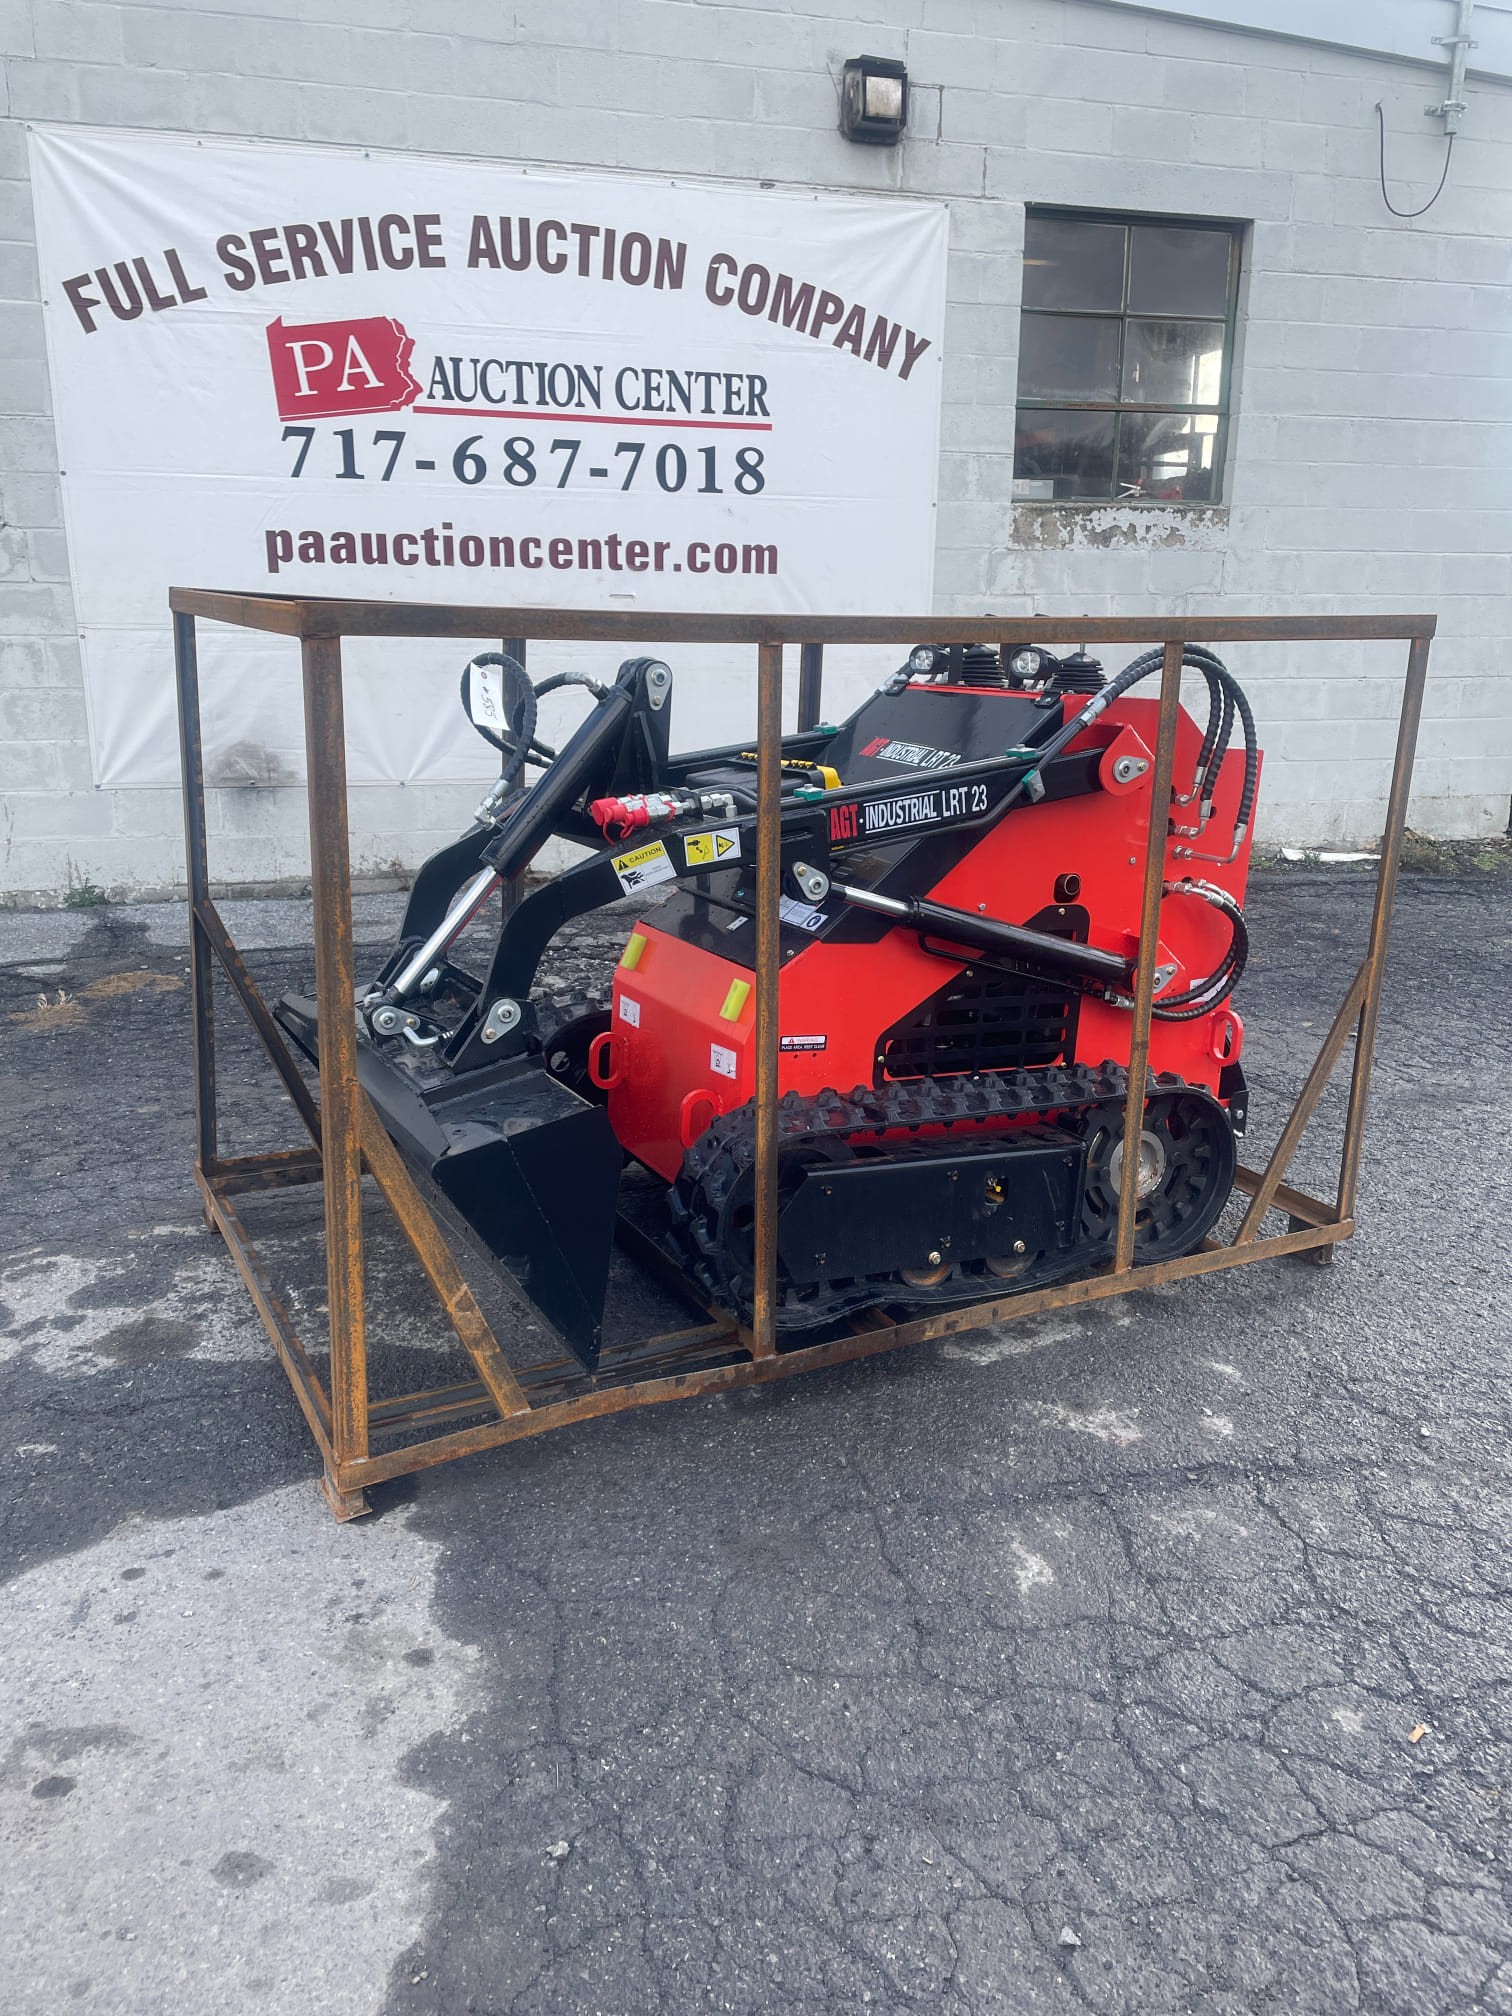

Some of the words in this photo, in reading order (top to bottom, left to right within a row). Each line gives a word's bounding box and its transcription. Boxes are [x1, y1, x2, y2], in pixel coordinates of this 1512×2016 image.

[62, 248, 208, 334] FULL
[216, 213, 447, 291] SERVICE
[467, 214, 688, 290] AUCTION
[705, 252, 932, 381] COMPANY
[284, 334, 385, 397] PA
[427, 355, 603, 410] AUCTION
[614, 366, 770, 417] CENTER
[280, 425, 766, 495] 717-687-7018
[265, 521, 778, 576] paauctioncenter.com
[879, 742, 929, 764] INDUSTRIAL
[920, 749, 951, 769] LRT
[830, 803, 859, 841] AGT
[865, 794, 937, 830] INDUSTRIAL
[941, 786, 969, 818] LRT
[971, 784, 988, 812] 23
[629, 846, 662, 863] CAUTION
